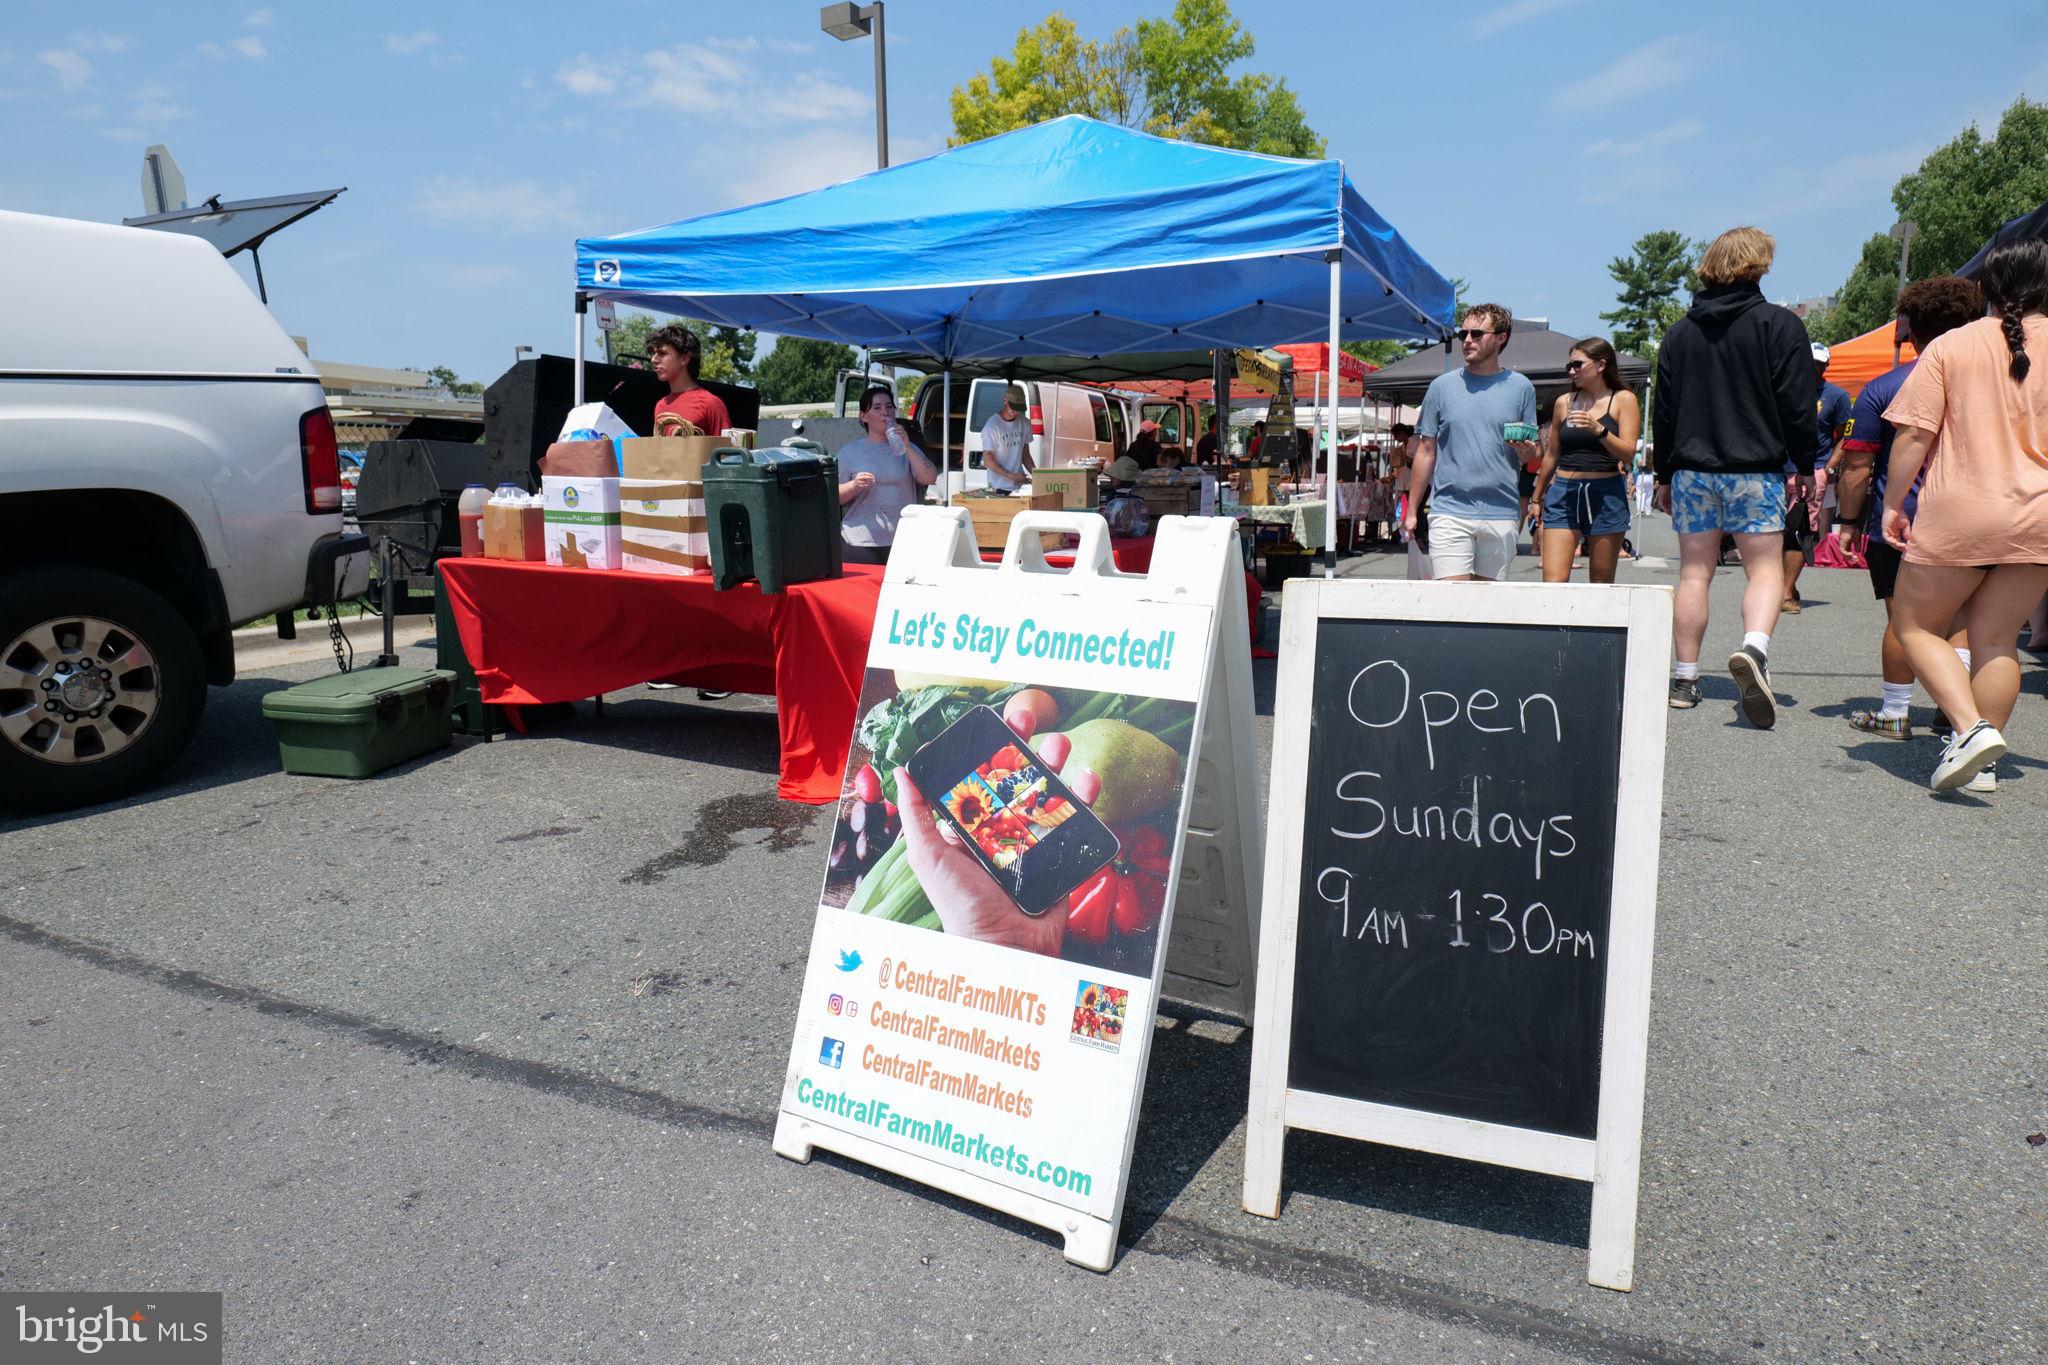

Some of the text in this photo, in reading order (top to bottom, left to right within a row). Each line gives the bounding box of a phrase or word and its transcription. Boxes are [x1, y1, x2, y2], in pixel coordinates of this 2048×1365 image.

[888, 608, 1176, 671] Let's Stay Connected!
[1347, 659, 1562, 771] Open
[1330, 770, 1576, 880] Sundays
[878, 956, 1047, 1027] @ CentralFarmMKTs
[869, 1000, 1041, 1072] CentralFarmMarkets
[862, 1043, 1034, 1120] CentralFarmMarkets
[796, 1078, 1092, 1197] CentralFarmMarkets.com
